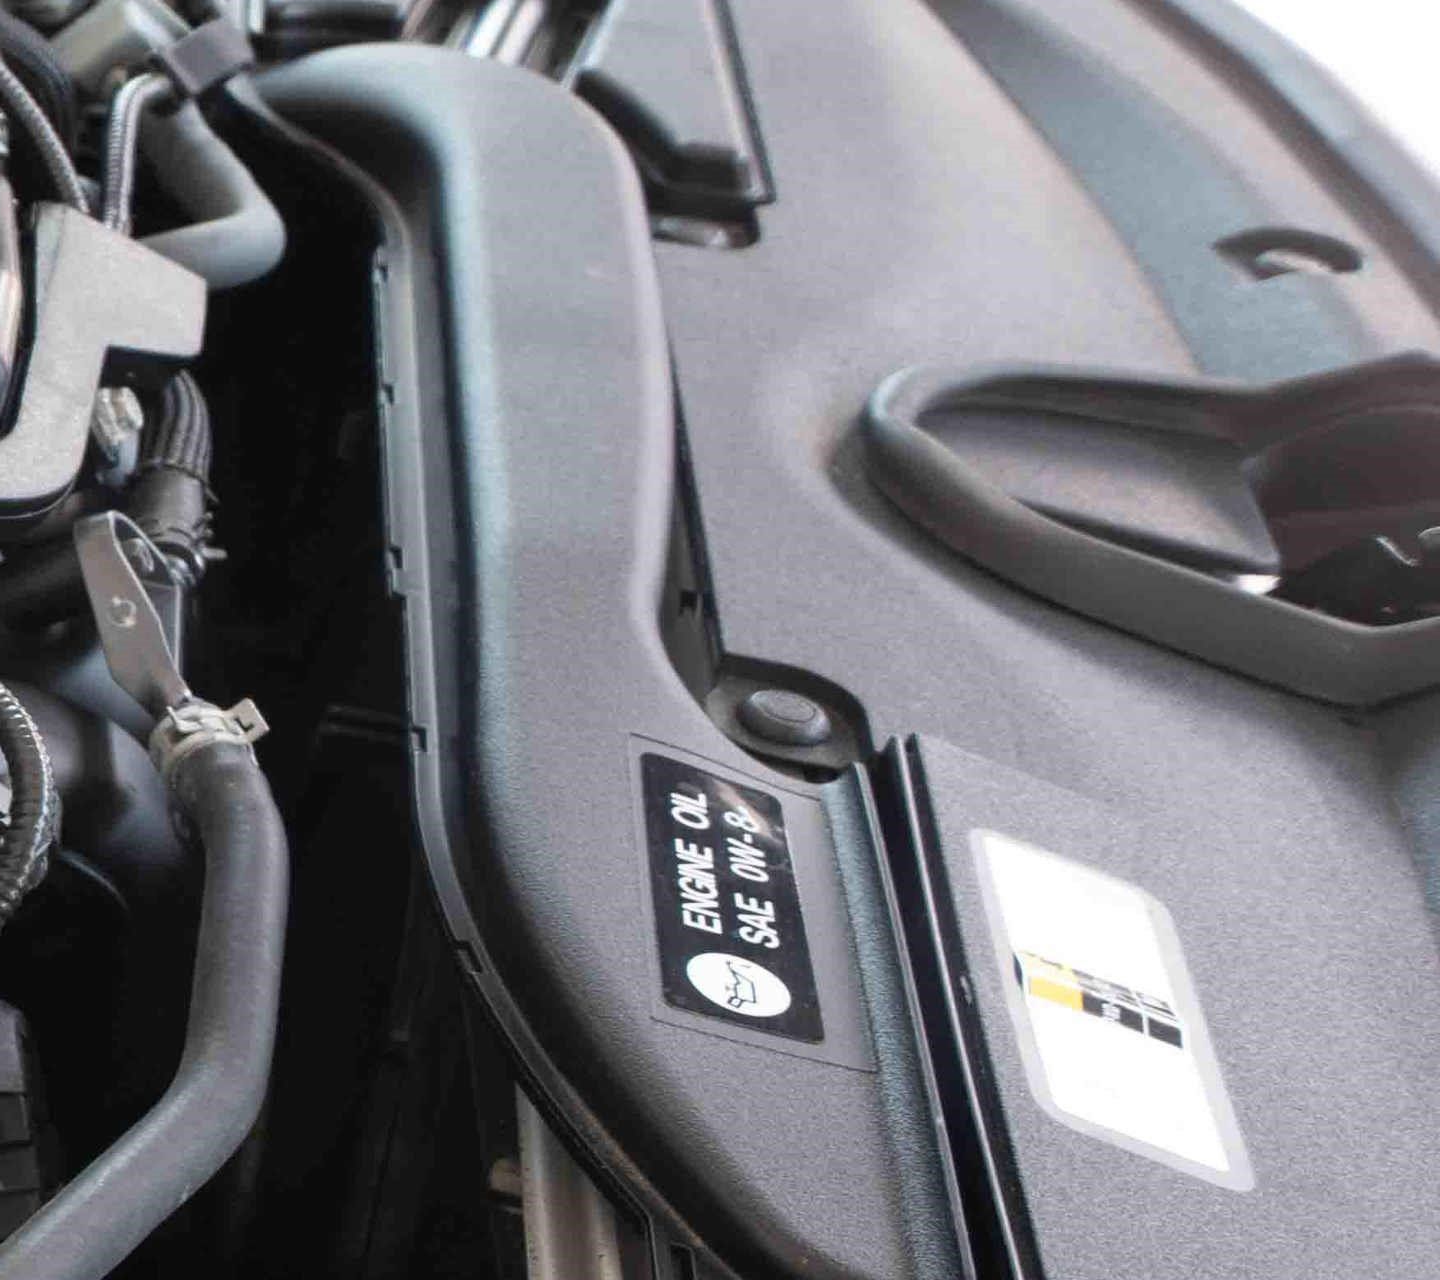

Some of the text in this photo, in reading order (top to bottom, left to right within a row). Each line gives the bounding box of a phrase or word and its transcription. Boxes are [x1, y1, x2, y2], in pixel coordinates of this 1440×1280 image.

[670, 792, 723, 935] ENGINE OIL
[723, 805, 780, 949] SAE 0W-8
